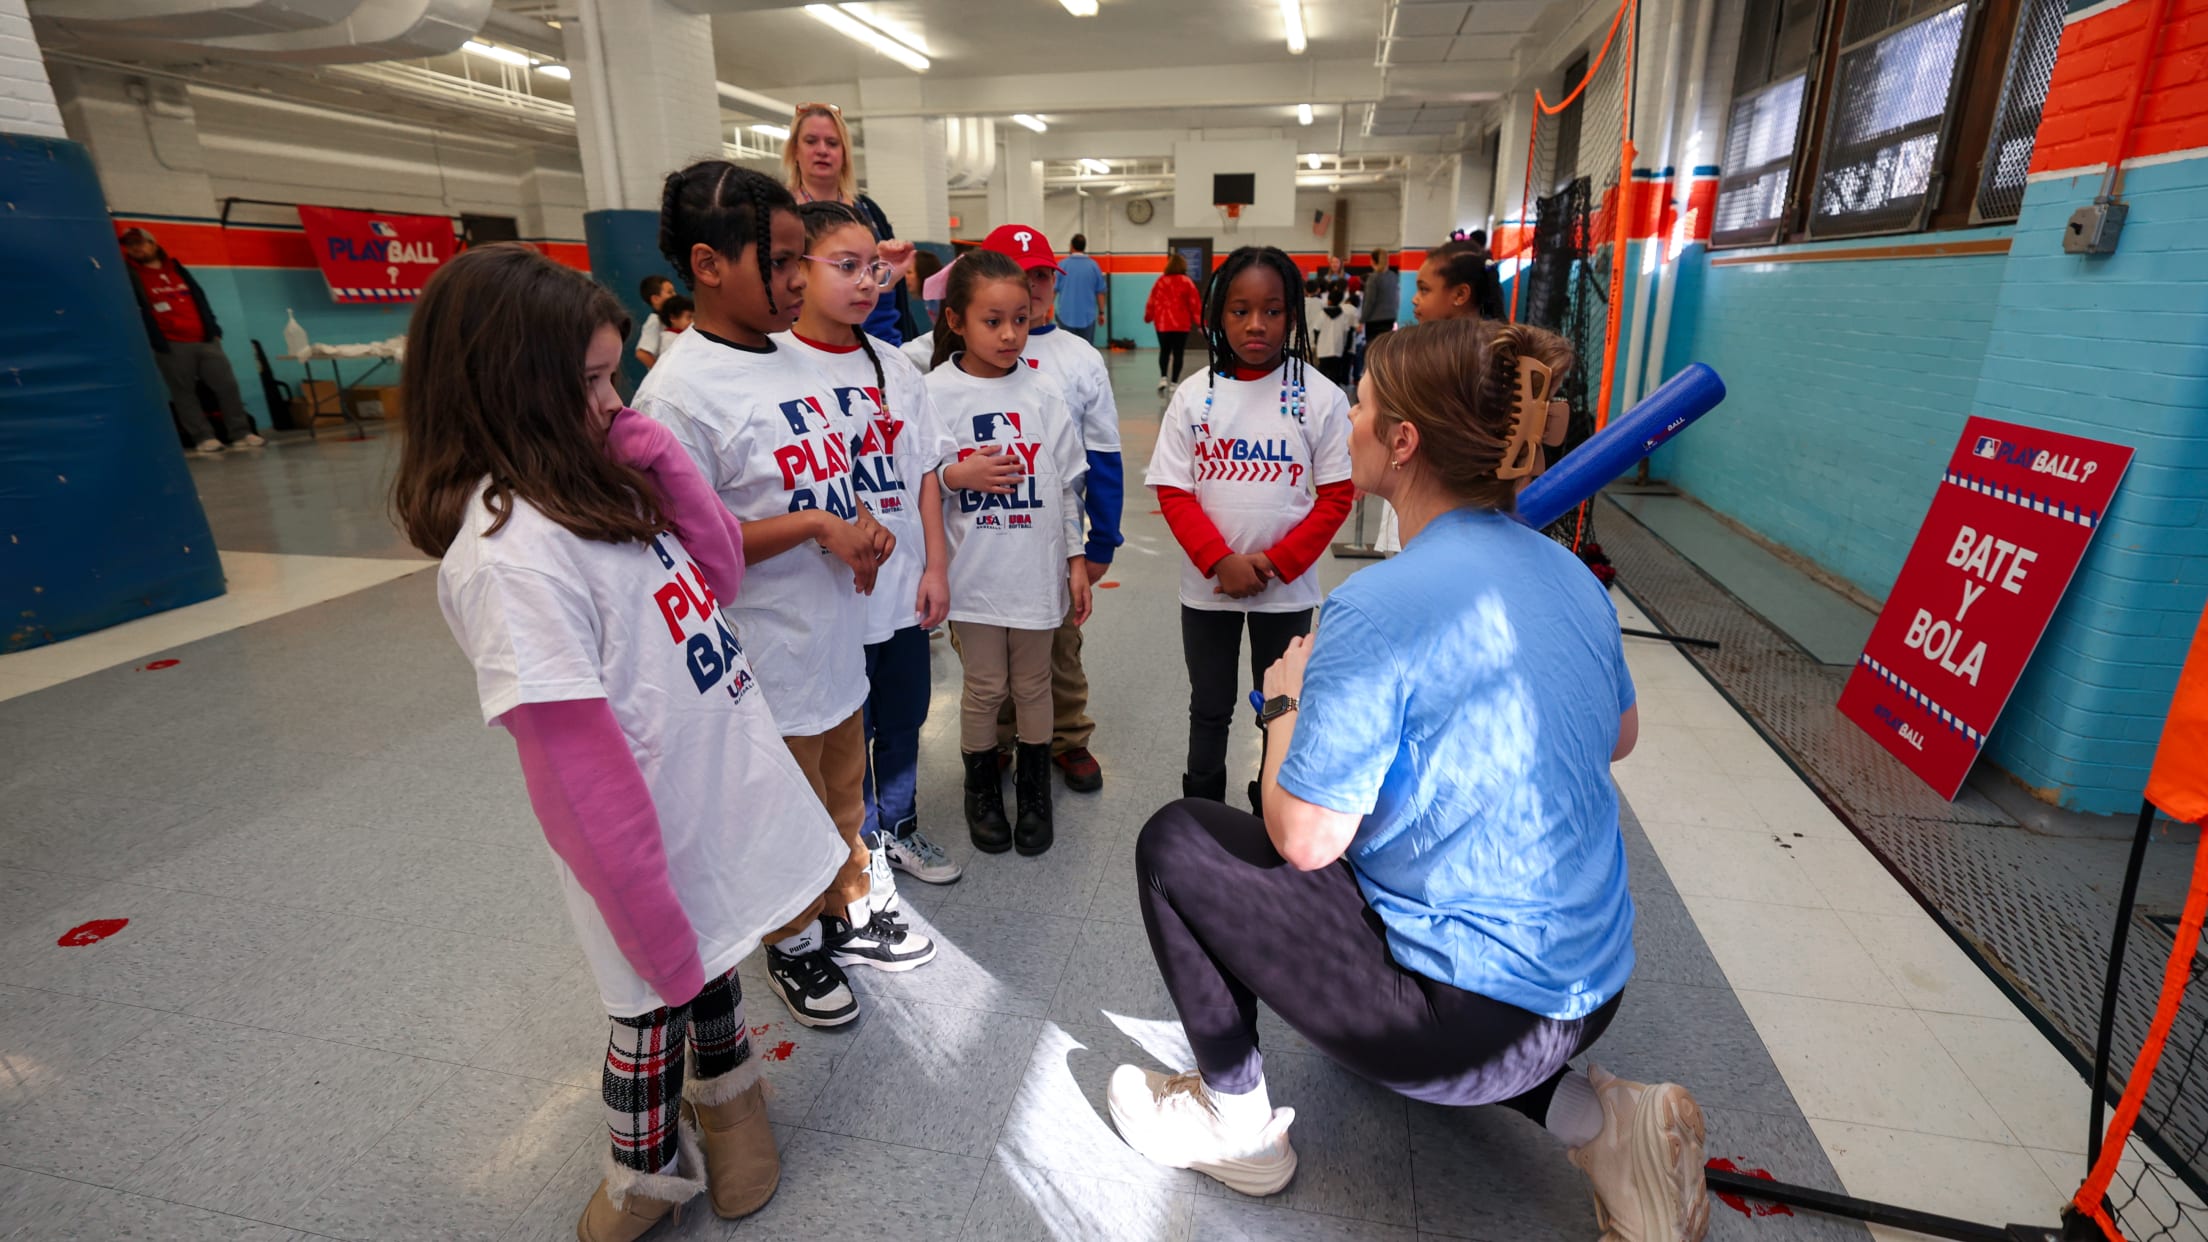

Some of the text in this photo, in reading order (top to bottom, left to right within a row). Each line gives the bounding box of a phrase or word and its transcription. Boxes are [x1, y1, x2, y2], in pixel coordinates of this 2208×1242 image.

[1013, 231, 1033, 252] P
[1288, 464, 1303, 486] P
[976, 515, 1000, 525] USA
[1946, 525, 2039, 595] BATE
[1955, 579, 1986, 622] Y
[1903, 608, 1988, 687] BOLA
[789, 940, 811, 953] PUMA
